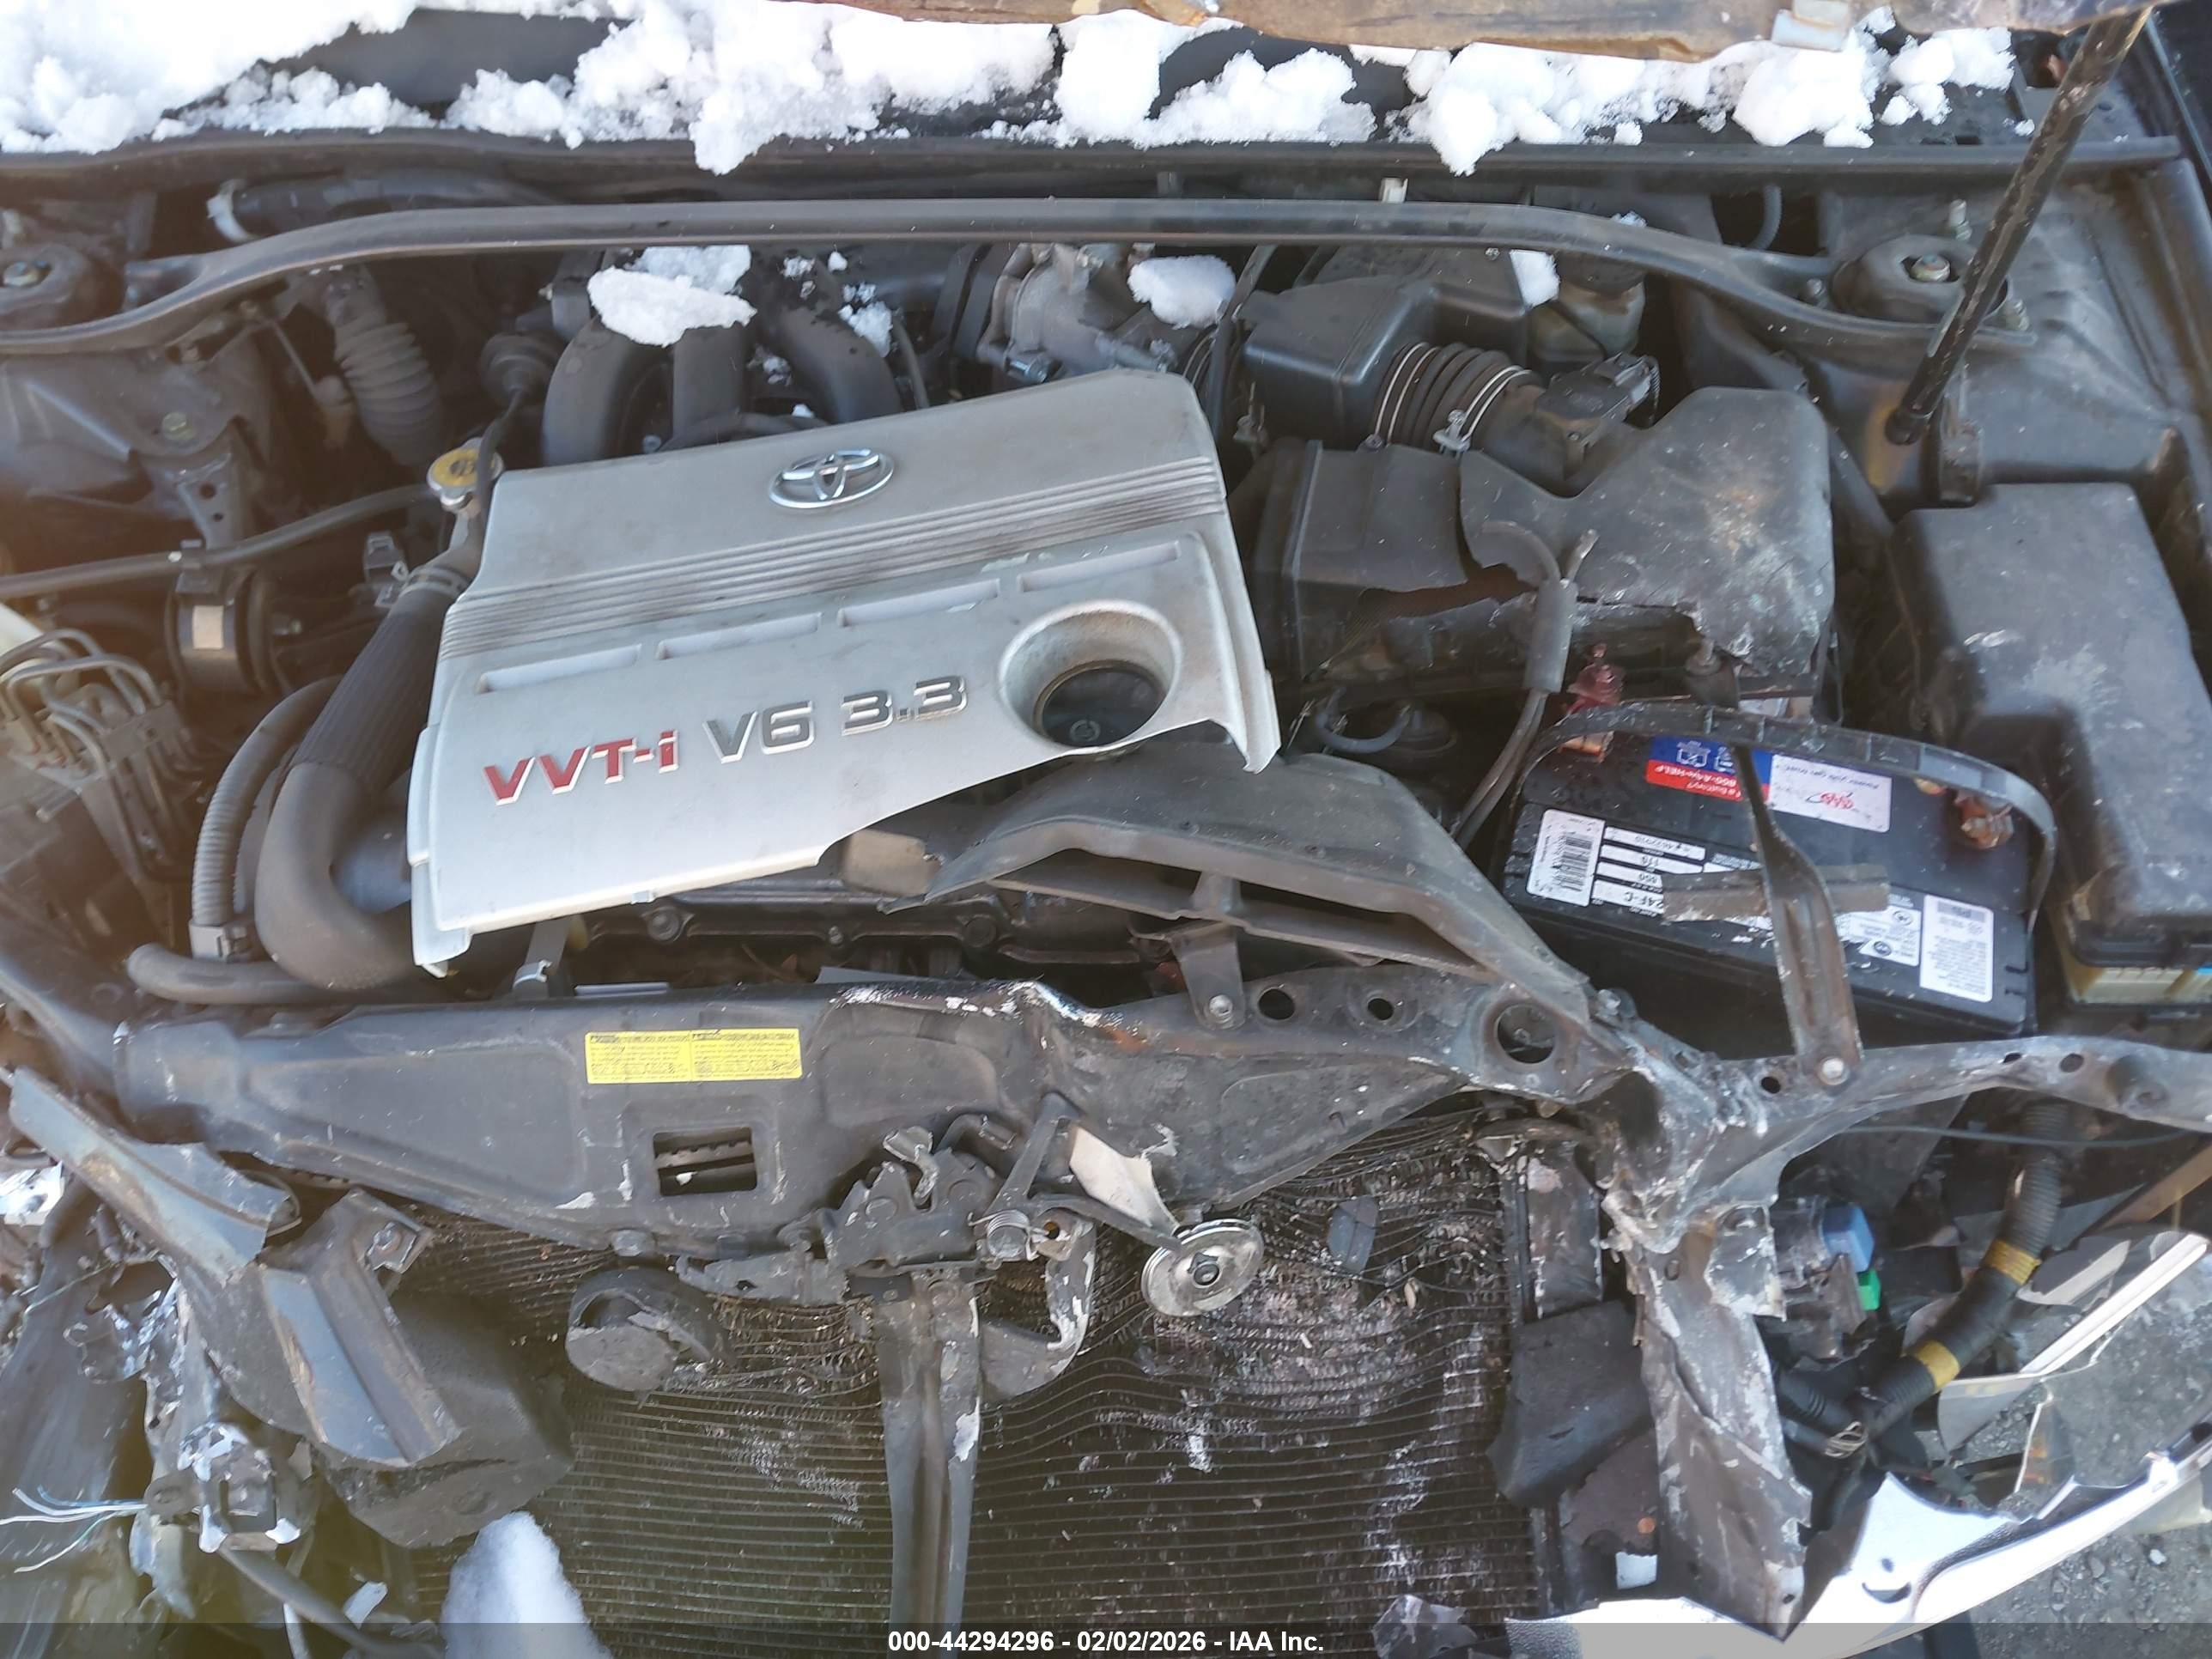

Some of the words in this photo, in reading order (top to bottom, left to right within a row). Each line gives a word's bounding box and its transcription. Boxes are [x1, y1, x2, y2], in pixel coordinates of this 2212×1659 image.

[483, 729, 680, 805] VVT-i
[703, 700, 815, 764] V6
[841, 675, 969, 737] 3.3
